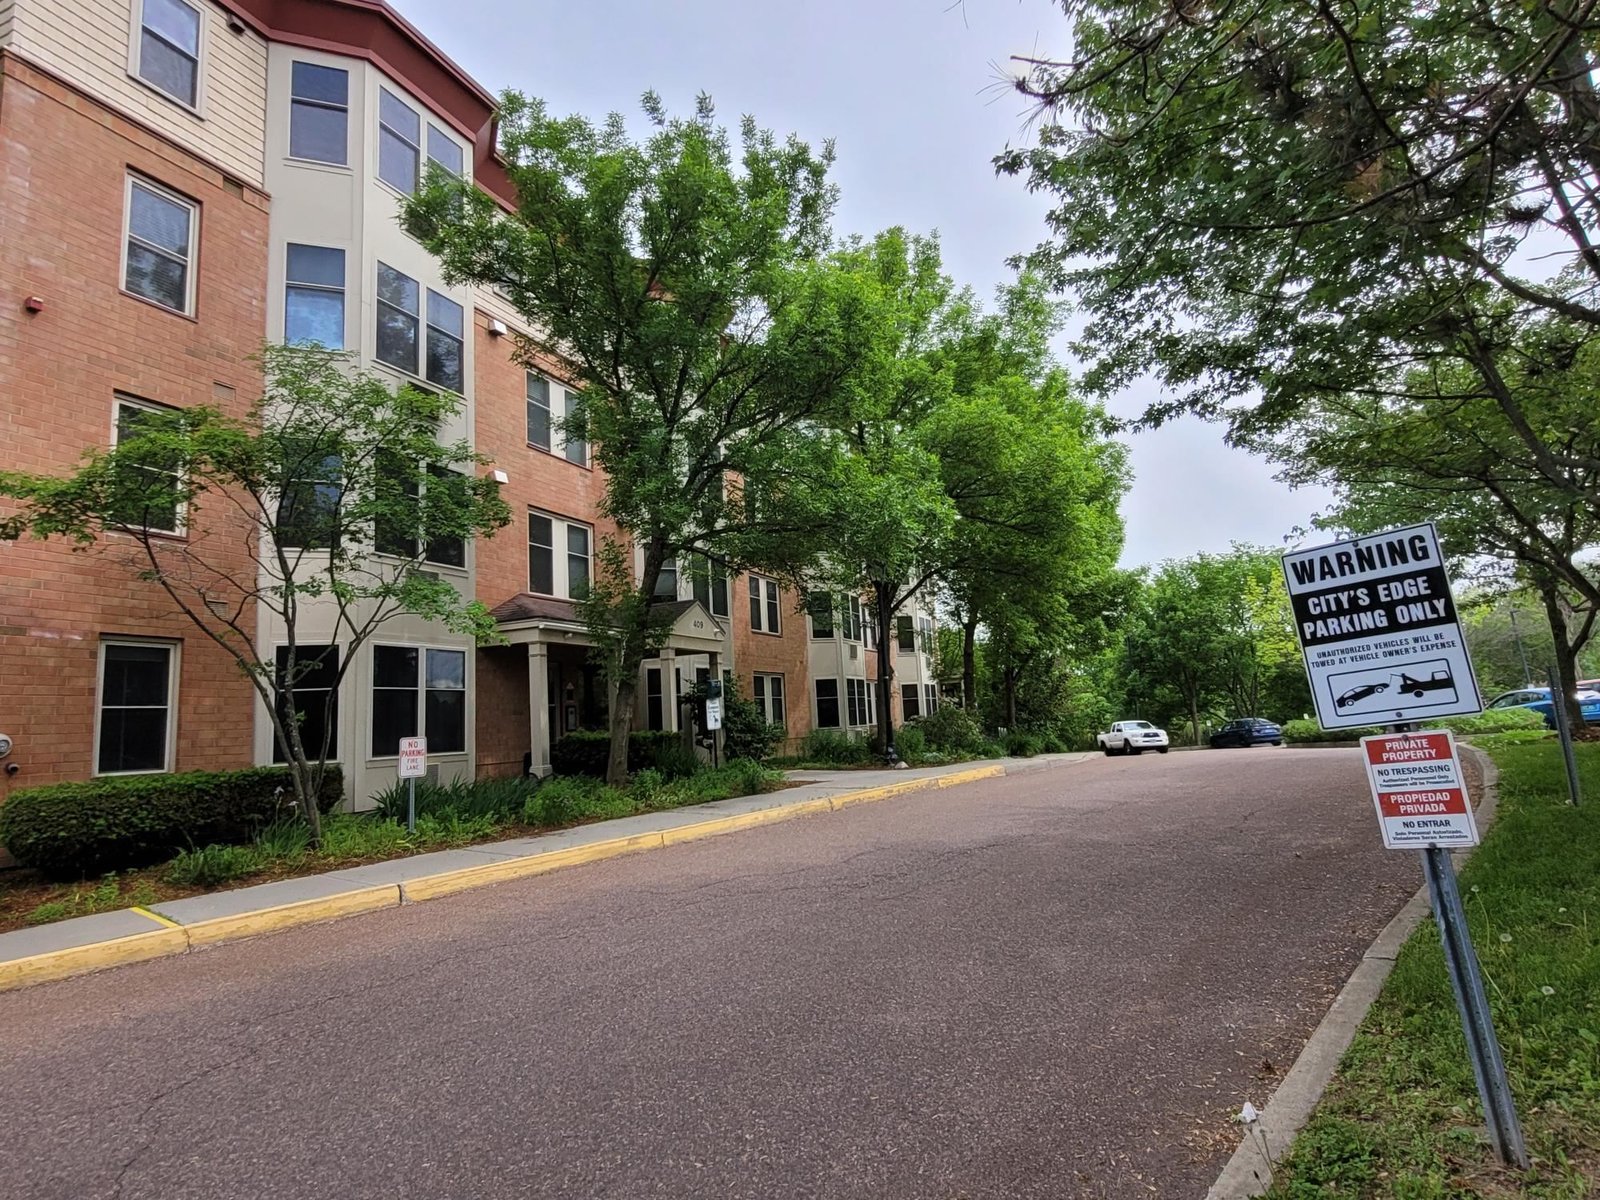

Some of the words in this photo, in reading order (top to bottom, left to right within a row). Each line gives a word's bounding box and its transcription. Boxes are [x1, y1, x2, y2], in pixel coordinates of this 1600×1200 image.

[1290, 534, 1430, 585] WARNING
[1307, 588, 1371, 615] CITY'S
[1377, 576, 1432, 603] EDGE
[693, 620, 704, 630] 409
[1303, 609, 1389, 639] PARKING
[1395, 598, 1447, 624] ONLY
[1316, 644, 1371, 659] UNAUTHORIZED
[1373, 638, 1410, 650] VEHICLES
[1413, 635, 1432, 644] WILL
[1434, 632, 1445, 640] BE
[1311, 658, 1336, 668] TOWED
[1338, 657, 1348, 665] AT
[1350, 653, 1380, 663] VEHICLE
[1382, 646, 1418, 658] OWNER'S
[1420, 640, 1457, 652] EXPENSE
[1385, 739, 1430, 751] PRIVATE
[1382, 749, 1437, 762] PROPERTY
[1377, 768, 1390, 777] NO
[1391, 764, 1451, 776] TRESPASSING
[1390, 792, 1451, 804] PROPIEDAD
[1400, 803, 1447, 814] PRIVADA
[1402, 820, 1415, 829] NO
[1417, 819, 1451, 828] ENTRAR
